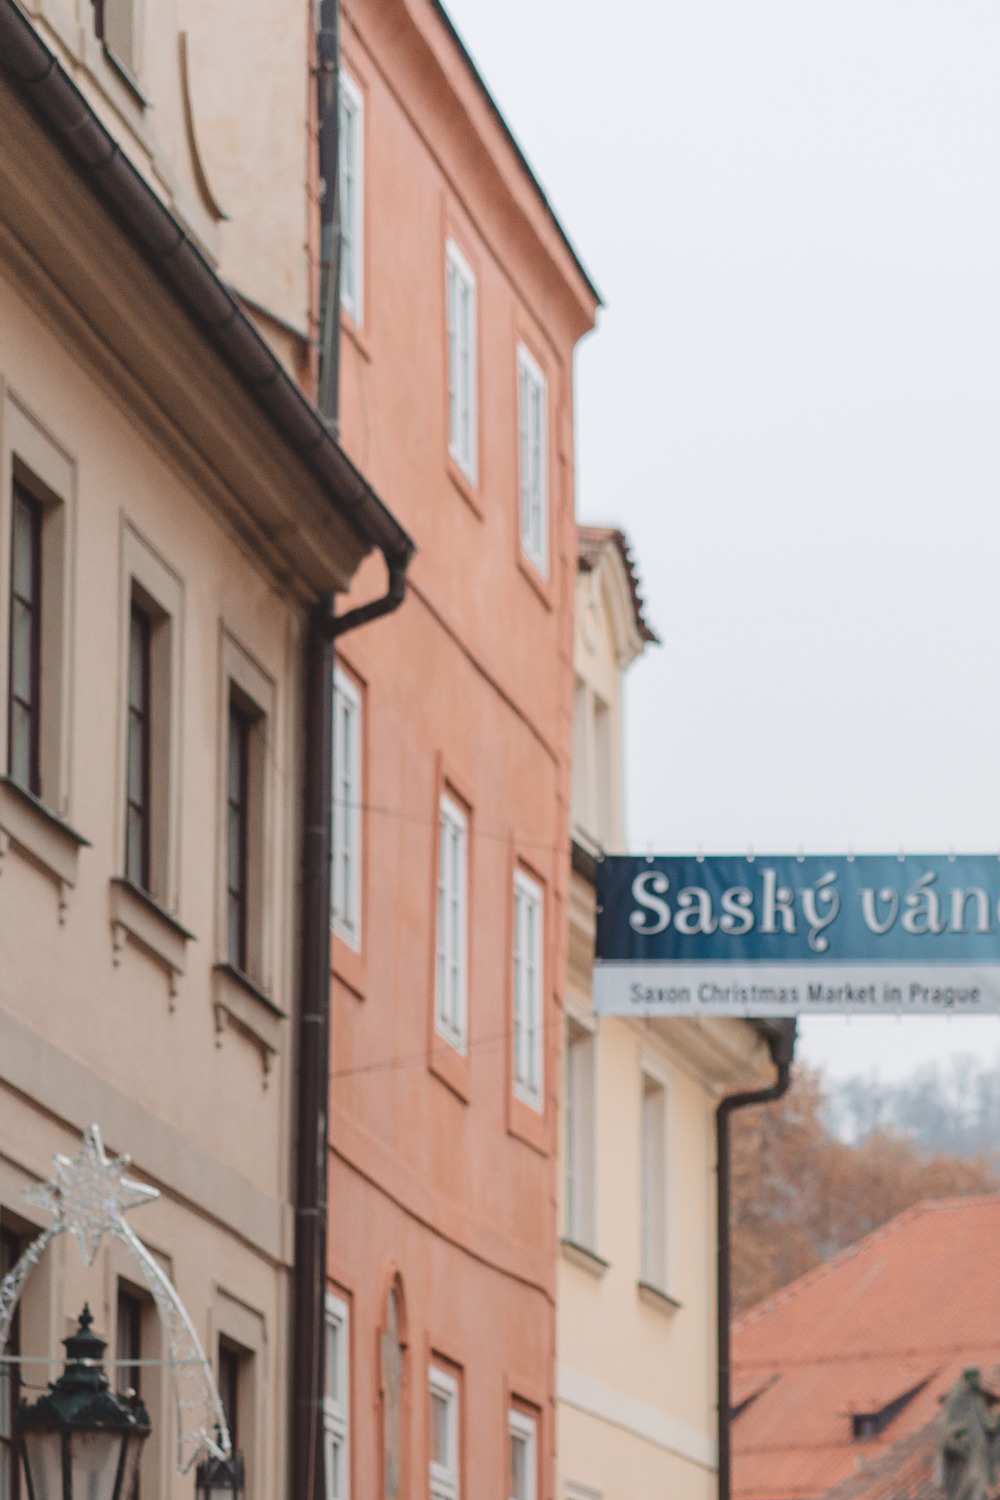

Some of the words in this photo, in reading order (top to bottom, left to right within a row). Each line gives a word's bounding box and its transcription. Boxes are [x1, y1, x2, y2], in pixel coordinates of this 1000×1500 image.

[629, 867, 840, 952] Saský
[629, 982, 691, 1004] Saxon
[698, 980, 800, 1004] Christmas
[807, 981, 876, 1003] Market
[883, 981, 902, 1003] in
[909, 982, 981, 1008] Prague
